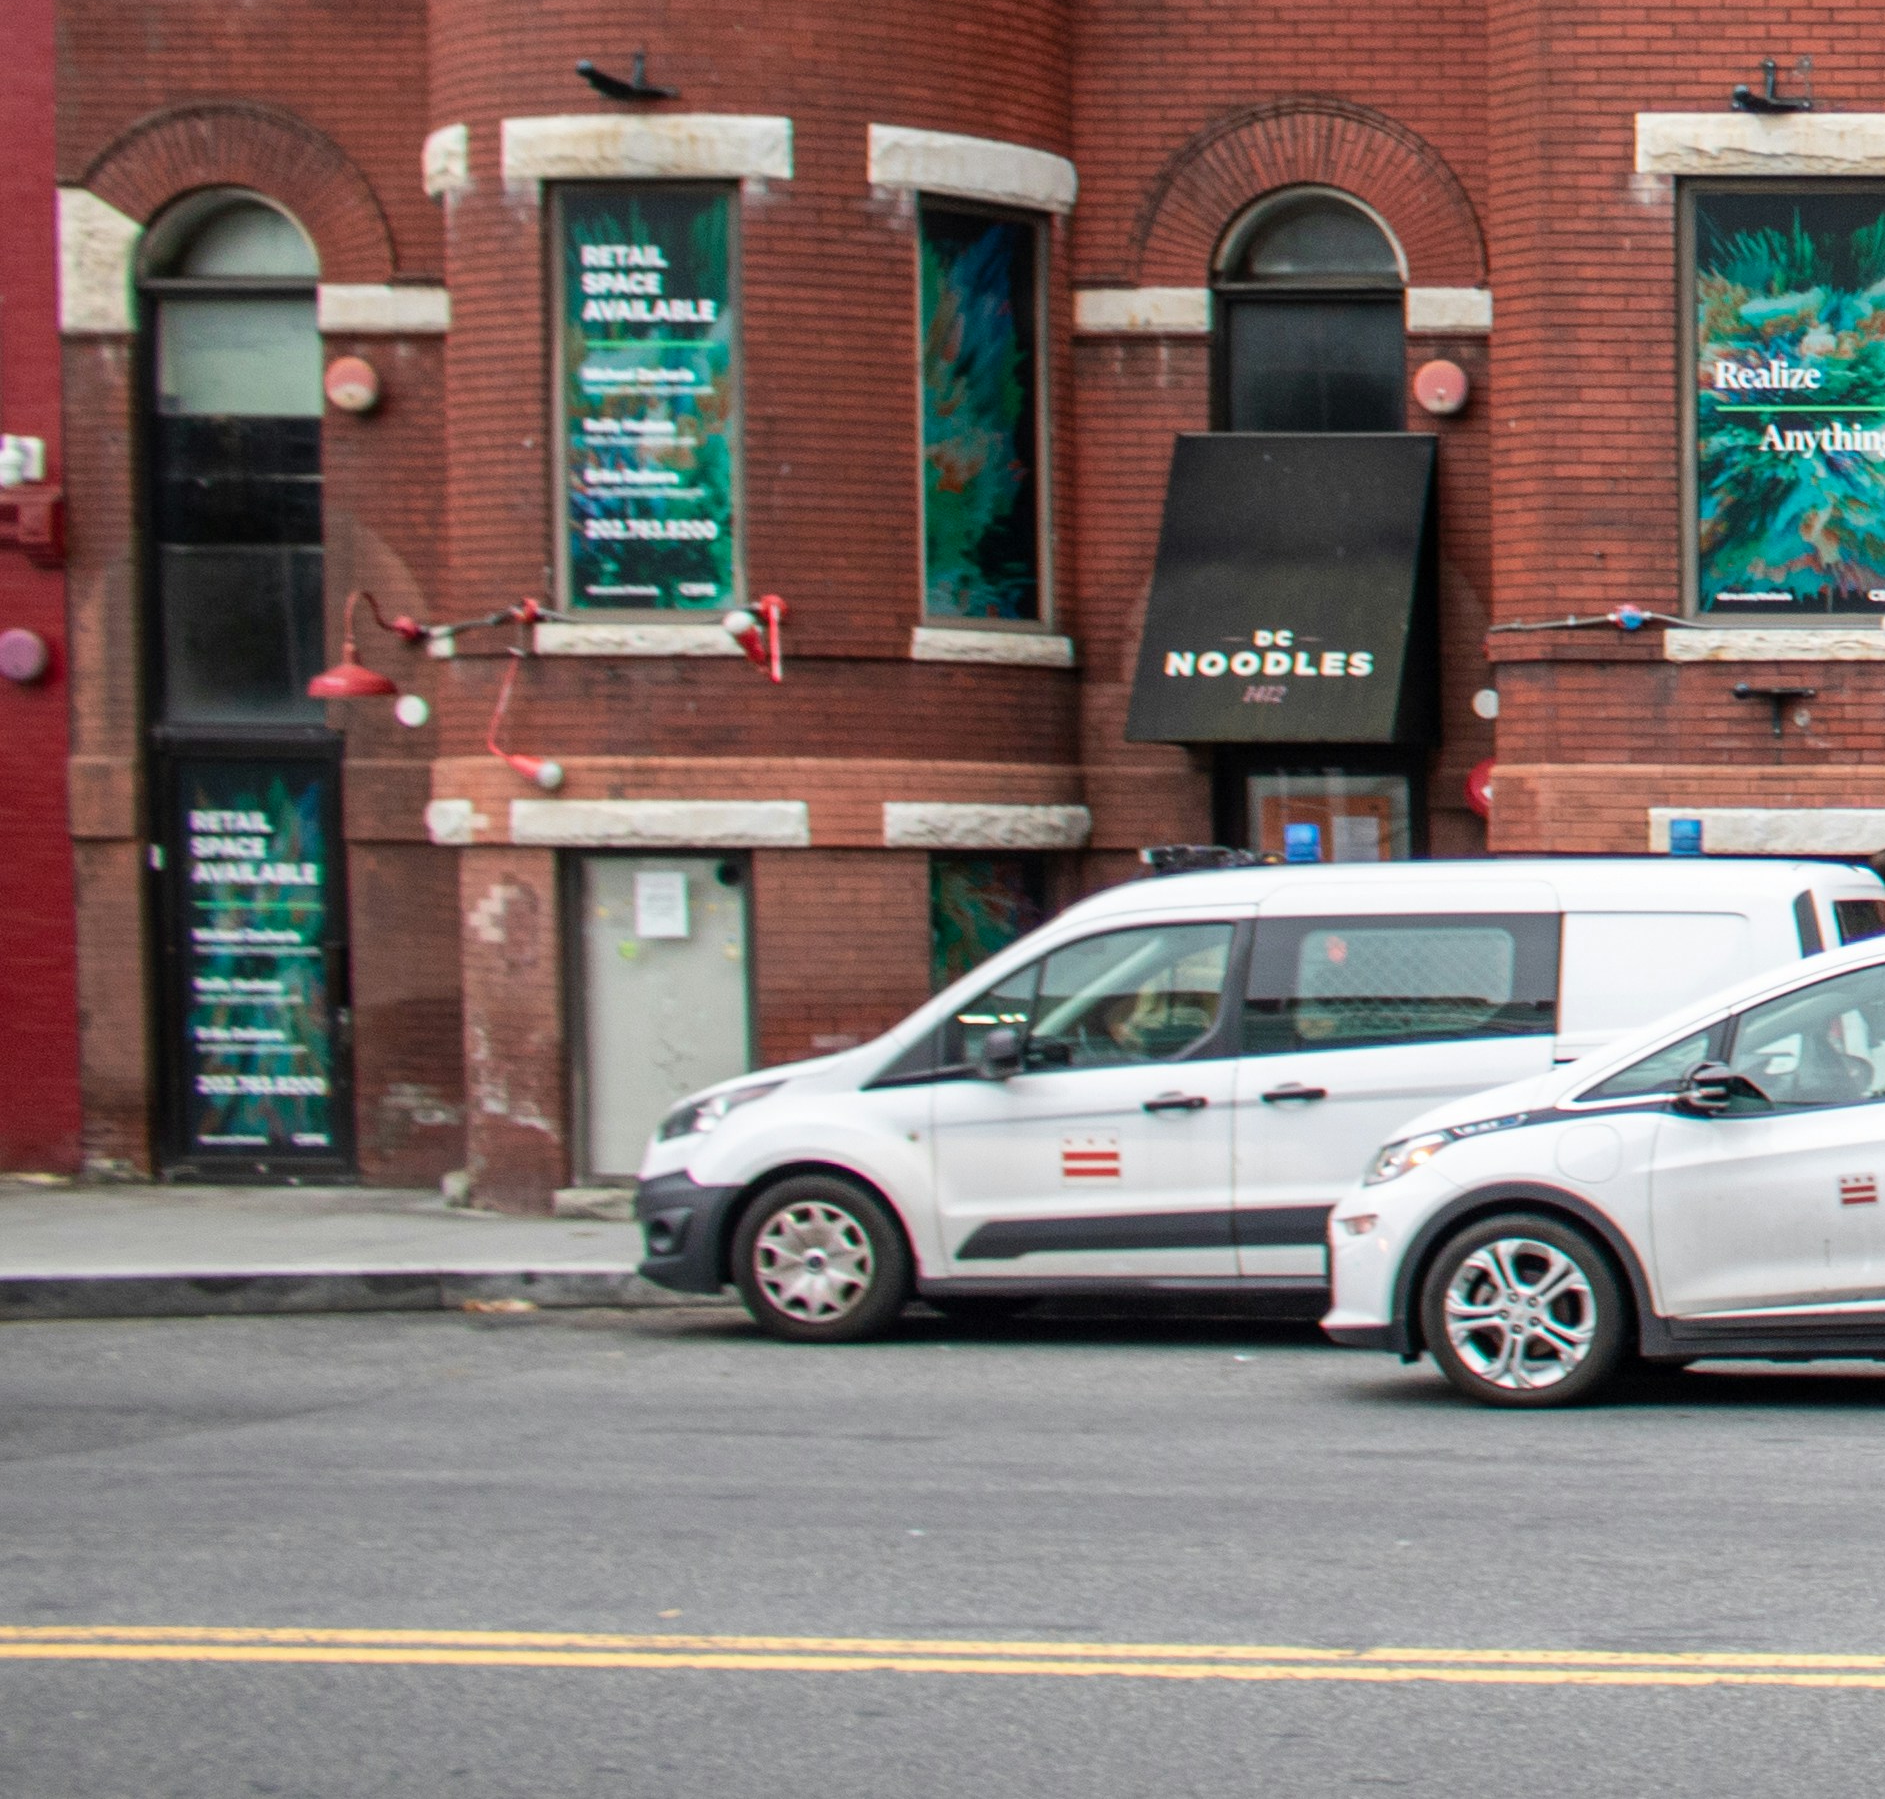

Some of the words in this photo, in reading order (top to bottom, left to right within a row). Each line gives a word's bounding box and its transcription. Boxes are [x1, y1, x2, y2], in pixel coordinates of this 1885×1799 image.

[581, 244, 669, 268] RETAIL
[581, 271, 662, 295] SPACE
[582, 299, 717, 322] AVAILABLE
[1714, 359, 1821, 389] Realize
[1253, 629, 1293, 647] DC
[1164, 651, 1374, 677] NOODLES
[188, 810, 273, 833] RETAIL
[189, 836, 267, 859] SPACE
[191, 862, 320, 885] AVAILABLE
